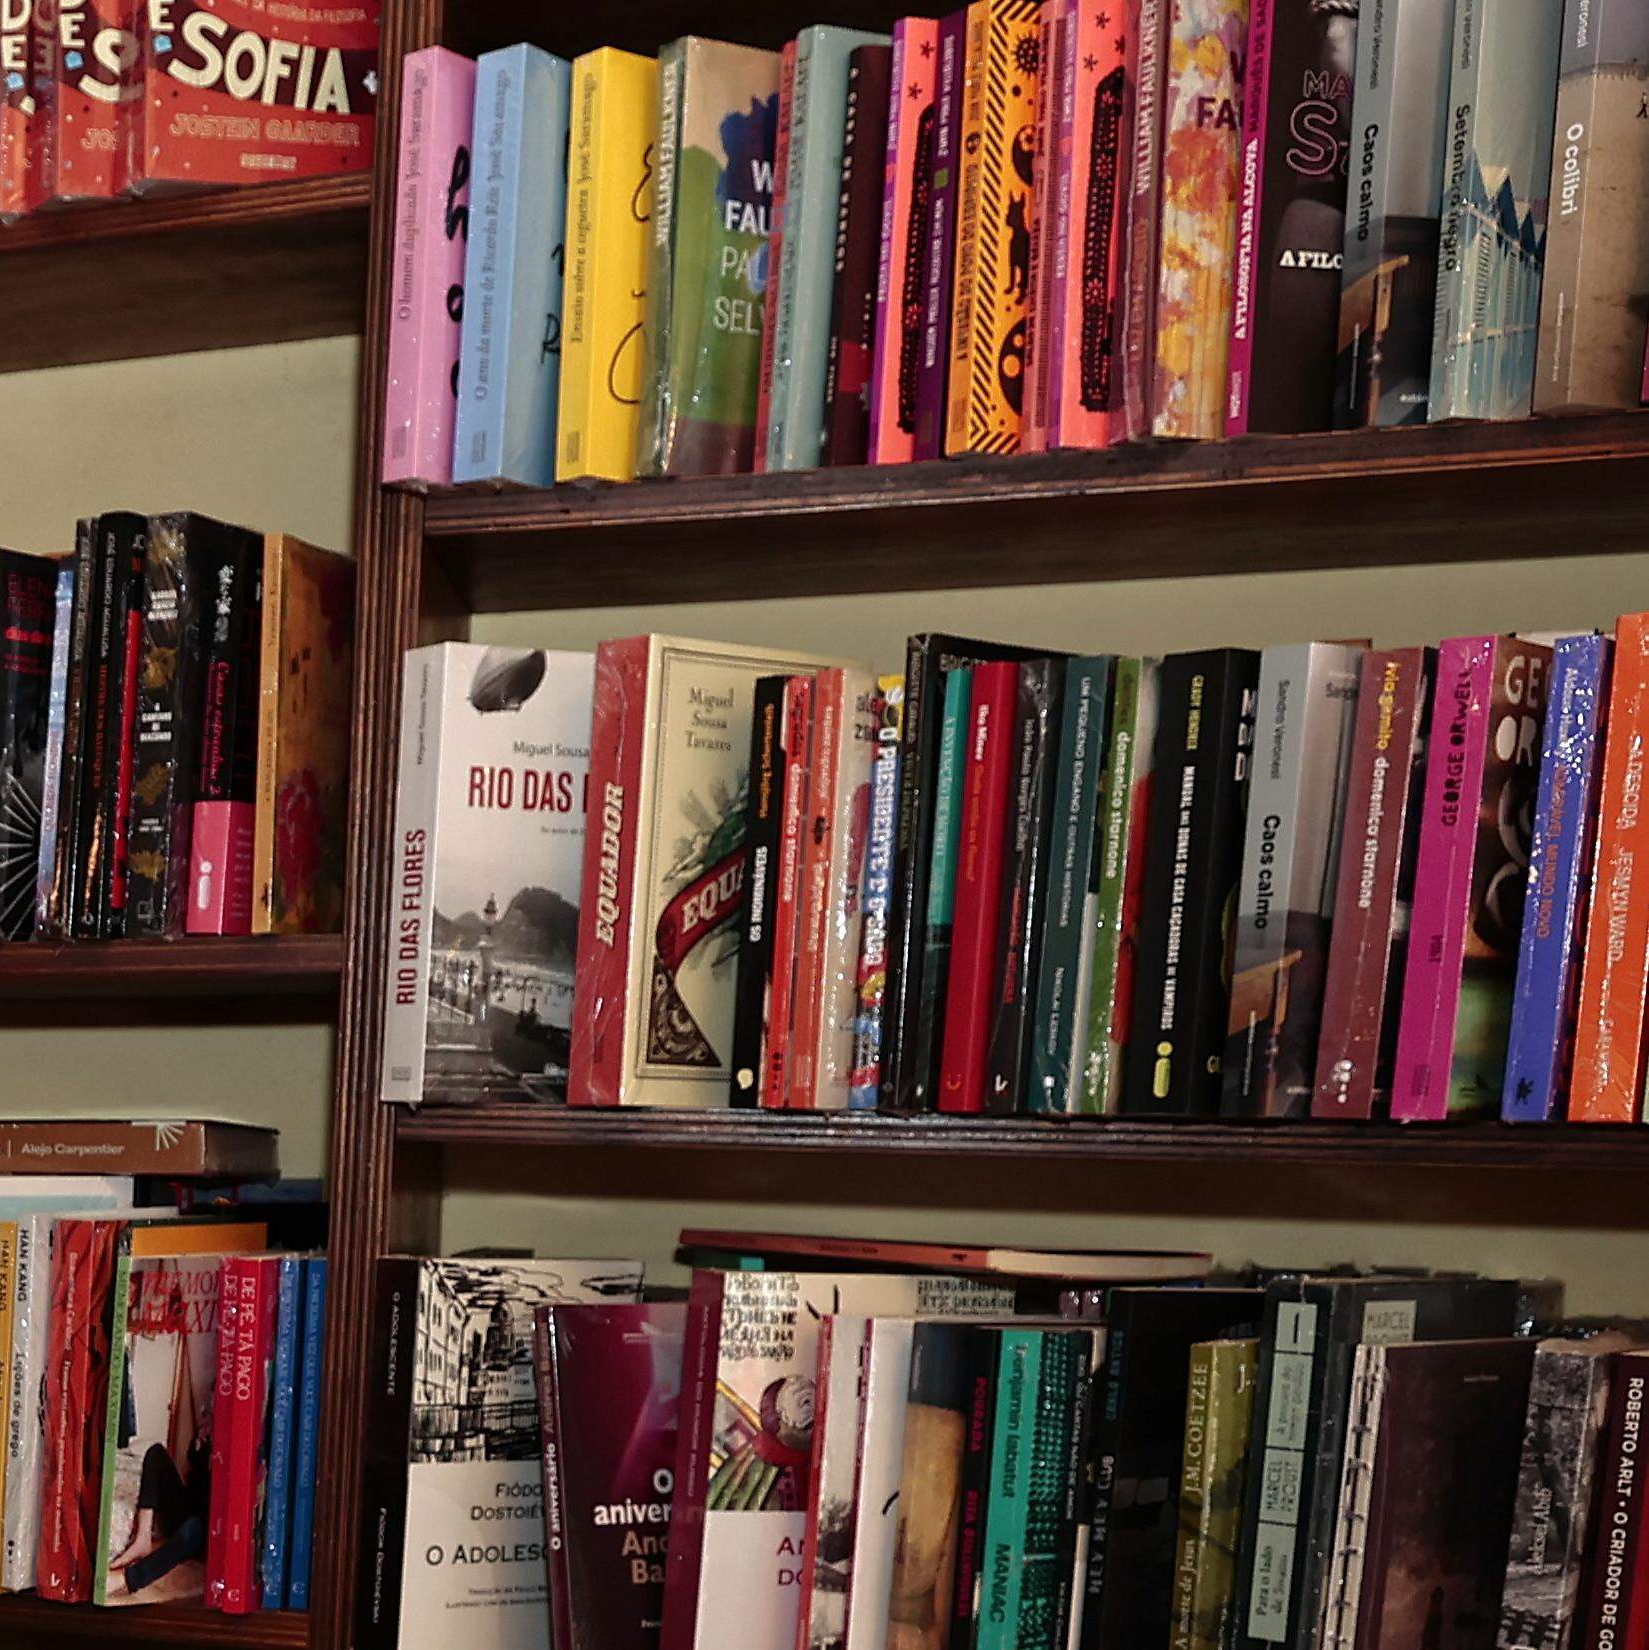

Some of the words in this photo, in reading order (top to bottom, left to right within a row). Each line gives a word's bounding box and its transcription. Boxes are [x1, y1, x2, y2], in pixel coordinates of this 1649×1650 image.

[167, 12, 351, 114] SOFIA
[169, 115, 258, 141] JOSTEIN
[265, 120, 361, 149] GAARDER
[1361, 123, 1380, 177] Caos
[1567, 122, 1583, 142] O
[1356, 179, 1375, 242] calmo
[468, 765, 512, 810] RIO
[522, 768, 573, 813] DAS
[1110, 731, 1131, 808] domenico
[1441, 749, 1465, 828] GEORGE
[594, 780, 625, 947] EQUADOR
[1104, 810, 1126, 880] starnone
[1260, 814, 1281, 865] Caos
[401, 829, 425, 912] FLORES
[1253, 868, 1279, 930] calmo
[399, 918, 421, 961] DAS
[396, 968, 418, 1005] RIO
[18, 1228, 30, 1260] HAN
[16, 1262, 29, 1303] KANG
[1187, 1363, 1209, 1459] COETZEE
[1622, 1376, 1645, 1454] ROBERTO
[545, 1443, 562, 1536] aniversário
[652, 1469, 673, 1493] O
[1616, 1455, 1635, 1498] ARLT
[549, 1537, 562, 1551] O
[1613, 1511, 1629, 1525] O
[987, 1541, 1013, 1622] MANIAC
[1603, 1526, 1628, 1601] CRIADOR
[1600, 1602, 1621, 1626] DE
